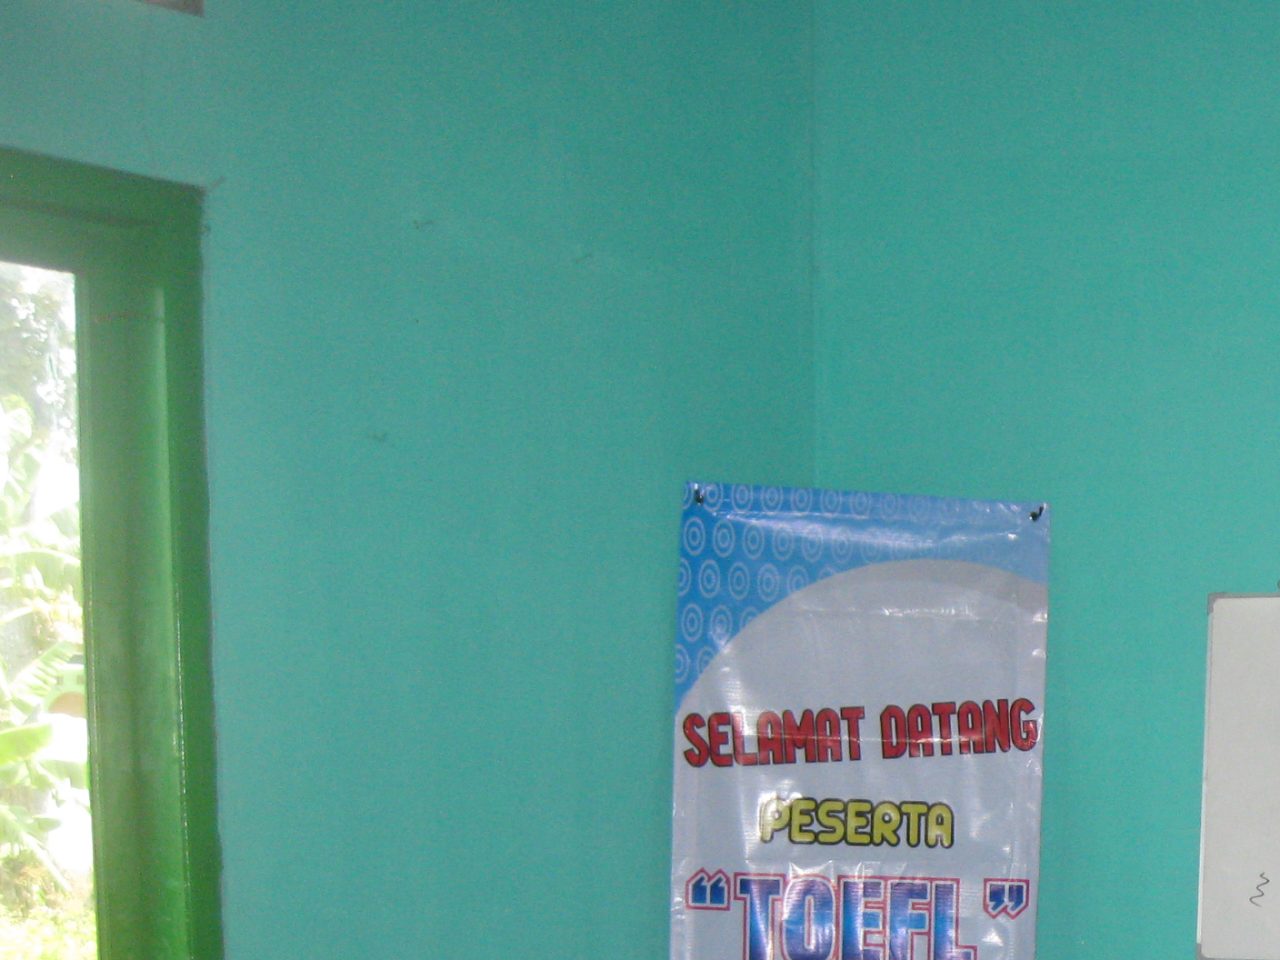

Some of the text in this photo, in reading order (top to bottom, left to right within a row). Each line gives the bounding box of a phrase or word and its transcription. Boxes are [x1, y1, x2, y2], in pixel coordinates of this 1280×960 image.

[682, 698, 1039, 768] SELAMAT DATANG
[759, 798, 955, 849] PESERTA
